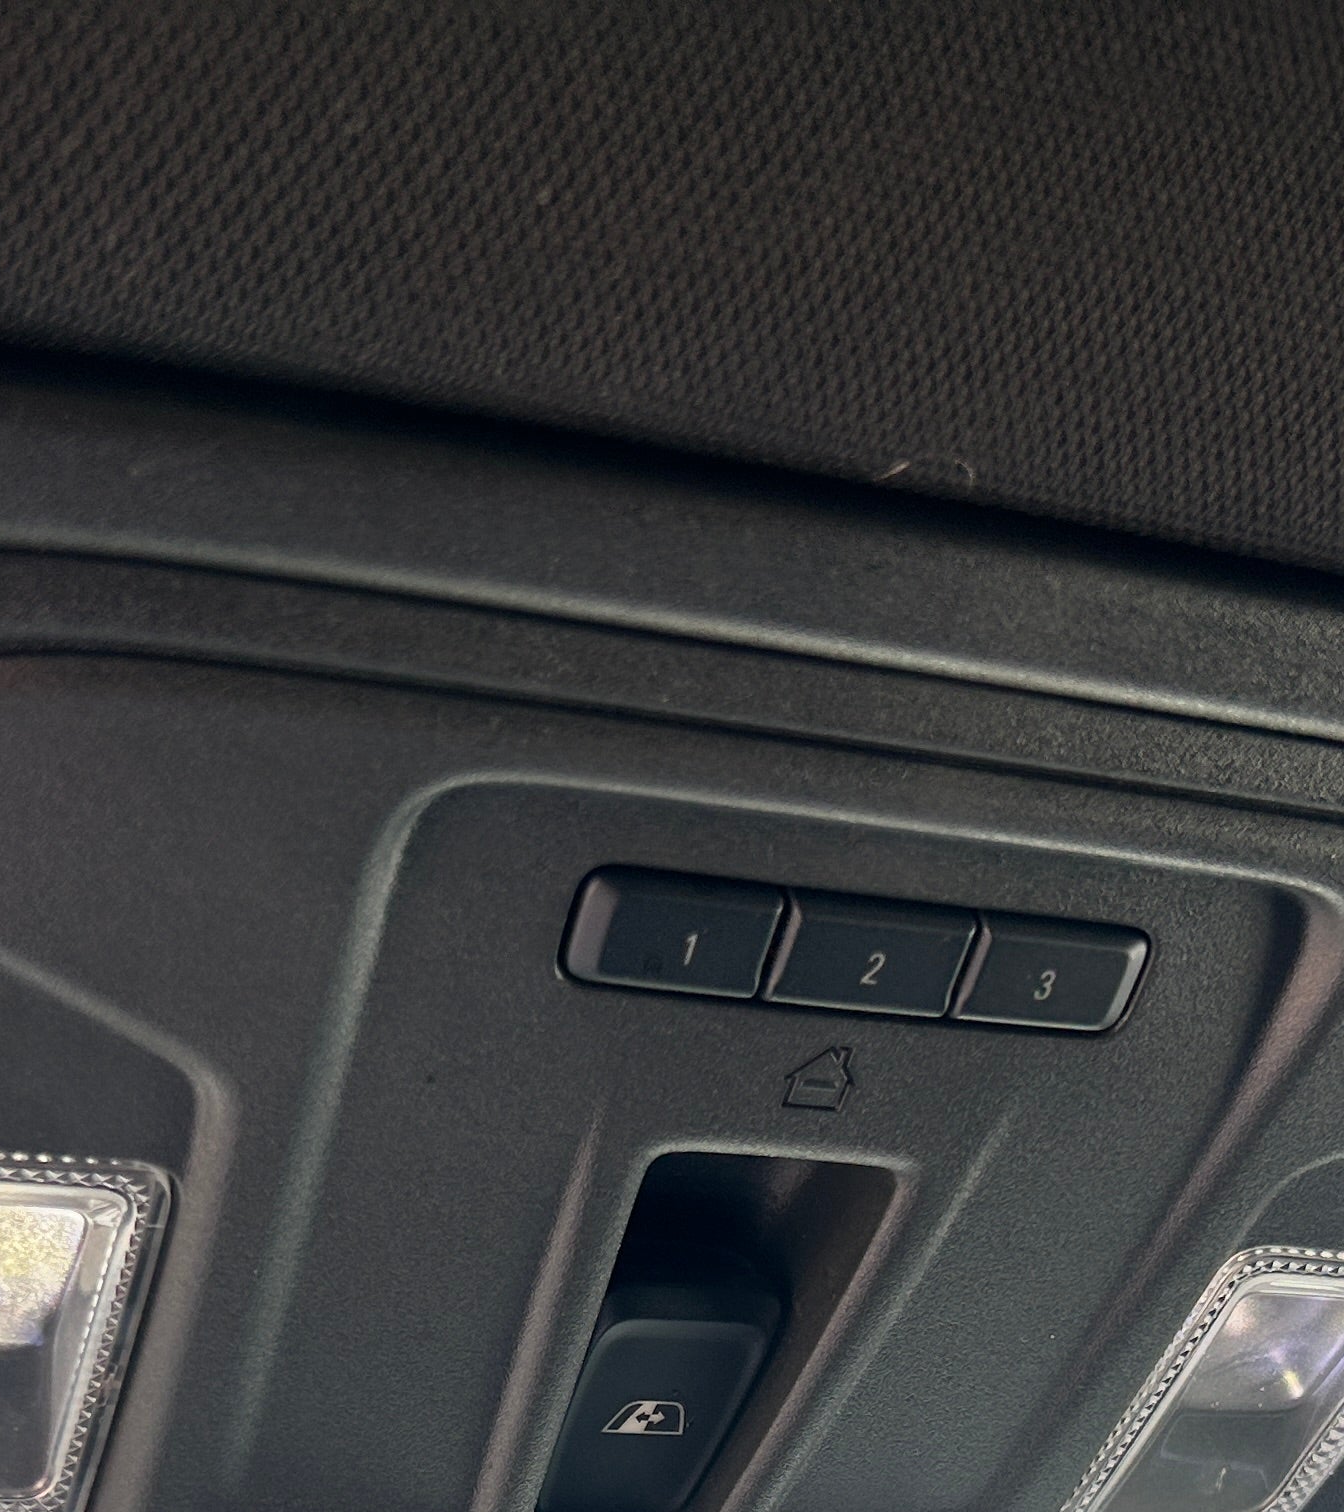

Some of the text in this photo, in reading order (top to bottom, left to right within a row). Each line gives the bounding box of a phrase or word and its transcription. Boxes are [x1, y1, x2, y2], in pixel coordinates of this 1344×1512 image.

[684, 933, 699, 967] 1
[860, 953, 887, 985] 2
[1034, 971, 1057, 1001] 3
